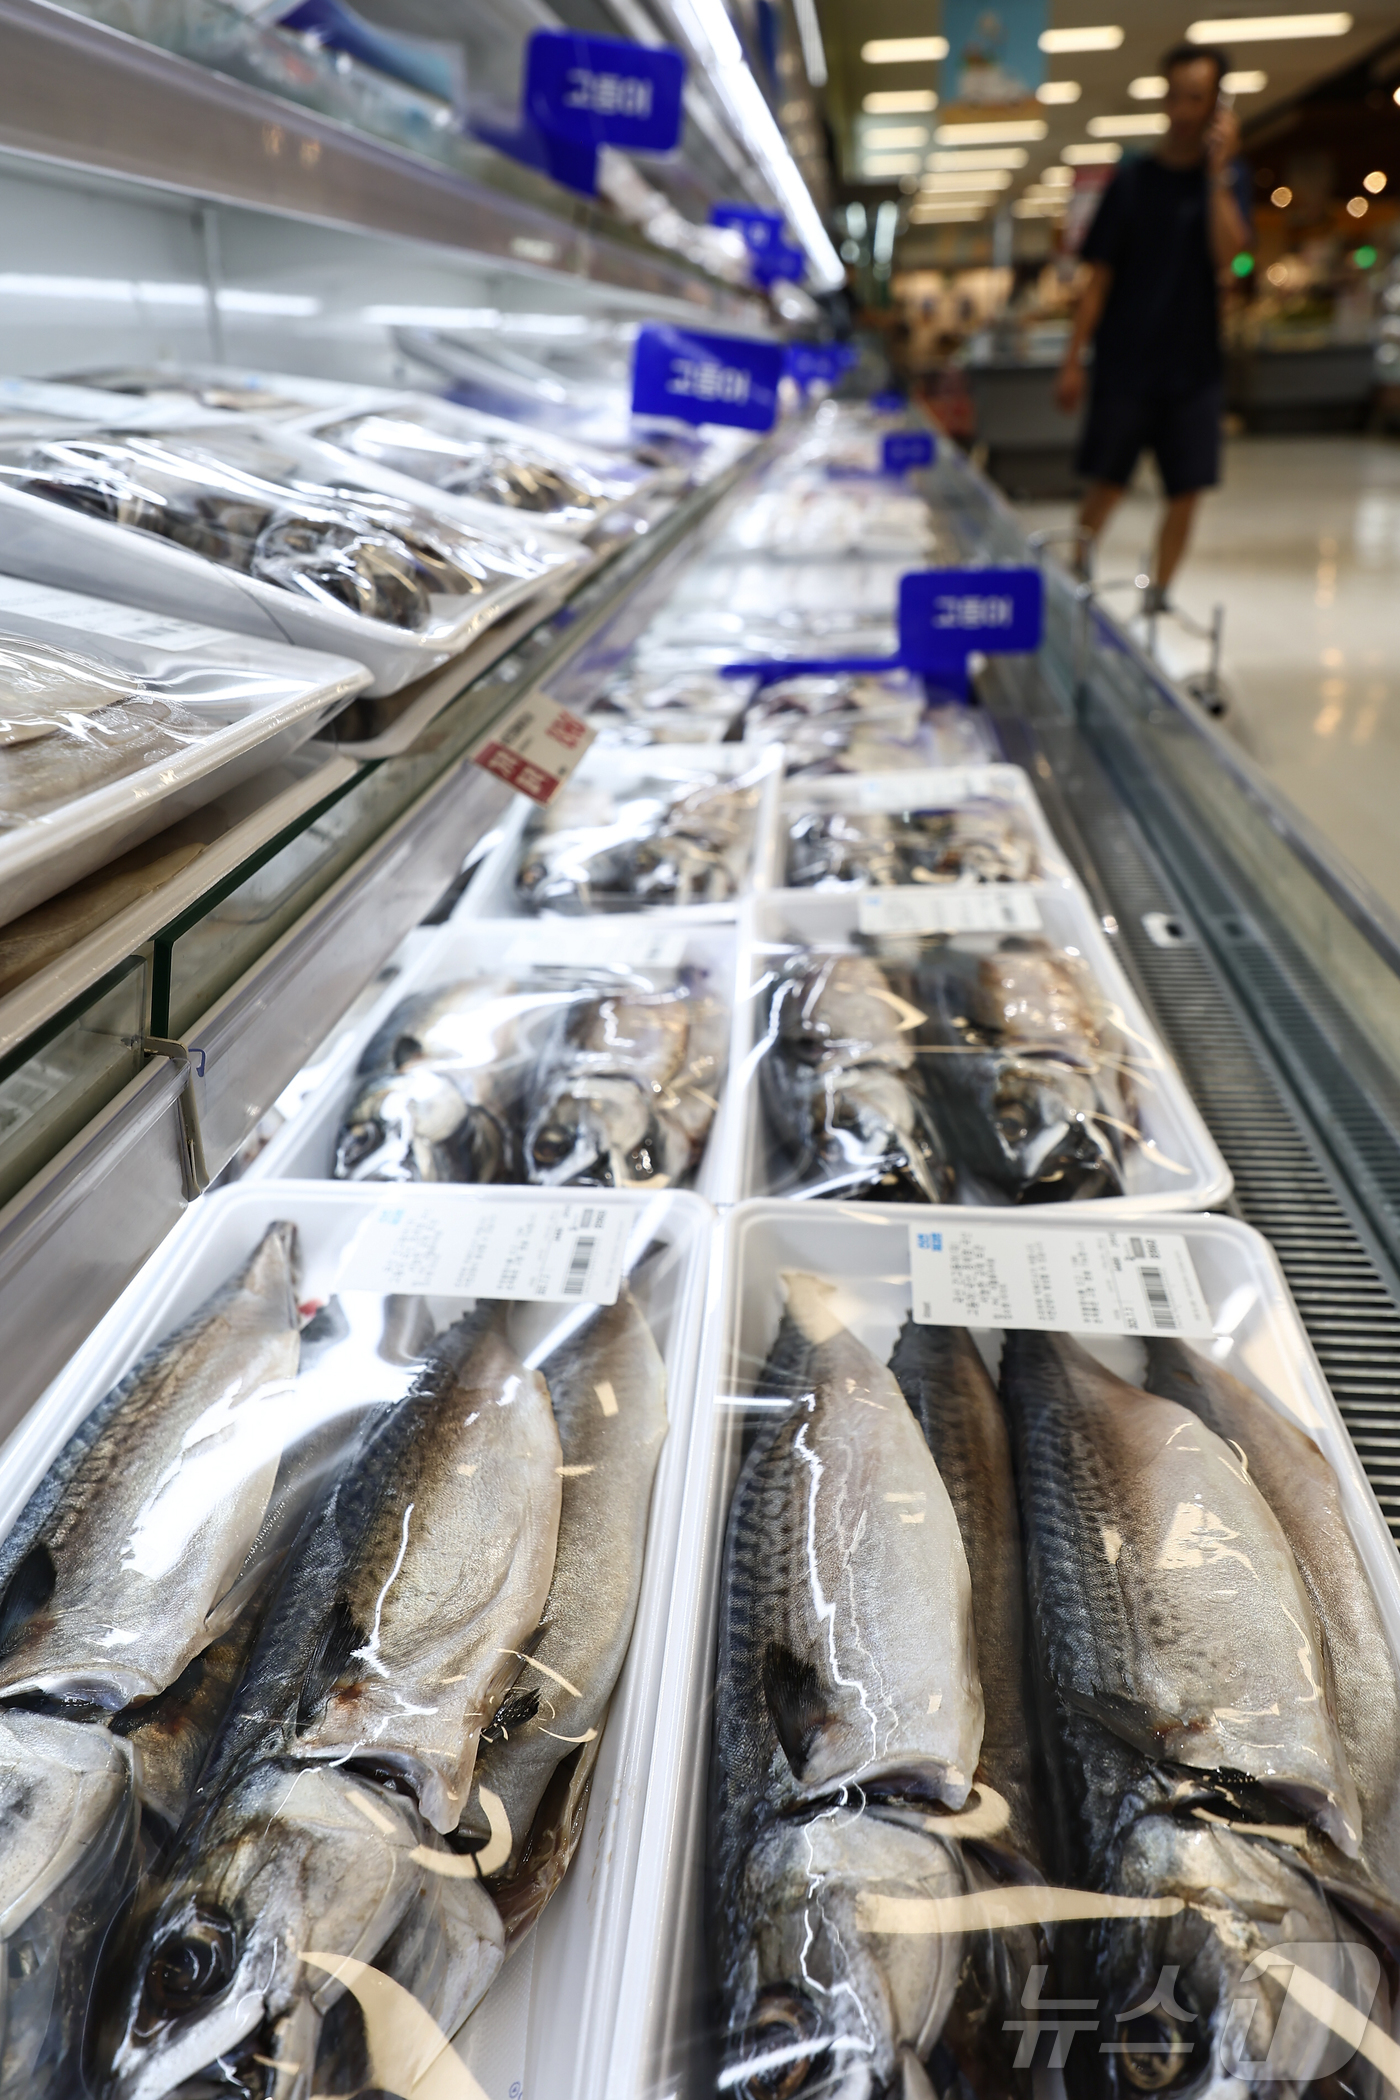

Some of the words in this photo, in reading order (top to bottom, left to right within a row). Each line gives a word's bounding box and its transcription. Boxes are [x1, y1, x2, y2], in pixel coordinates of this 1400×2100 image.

[563, 68, 654, 119] 고등어
[667, 358, 751, 405] 고등어
[933, 595, 1013, 630] 고등어
